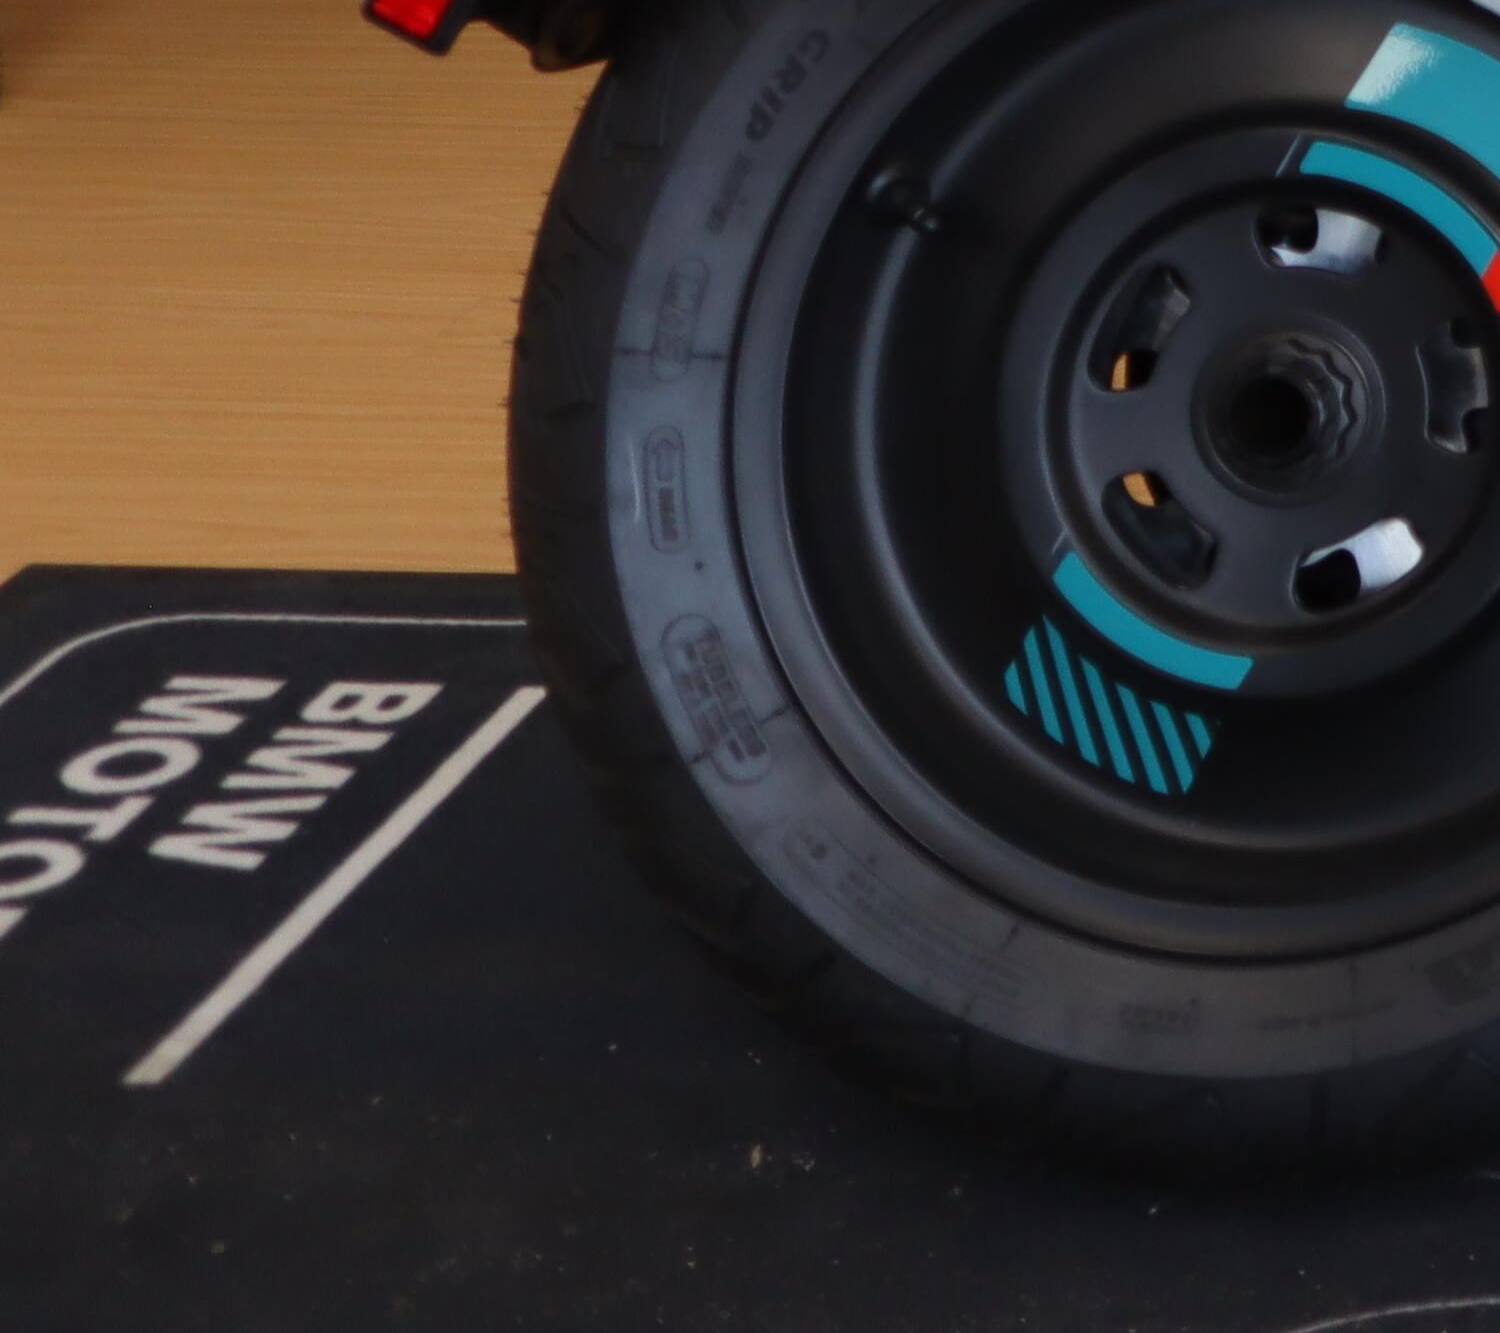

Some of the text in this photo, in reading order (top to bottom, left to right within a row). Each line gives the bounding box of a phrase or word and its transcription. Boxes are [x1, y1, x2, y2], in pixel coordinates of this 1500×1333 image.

[745, 27, 831, 143] GRIP
[0, 675, 288, 933] MOTO
[149, 682, 446, 871] BMW
